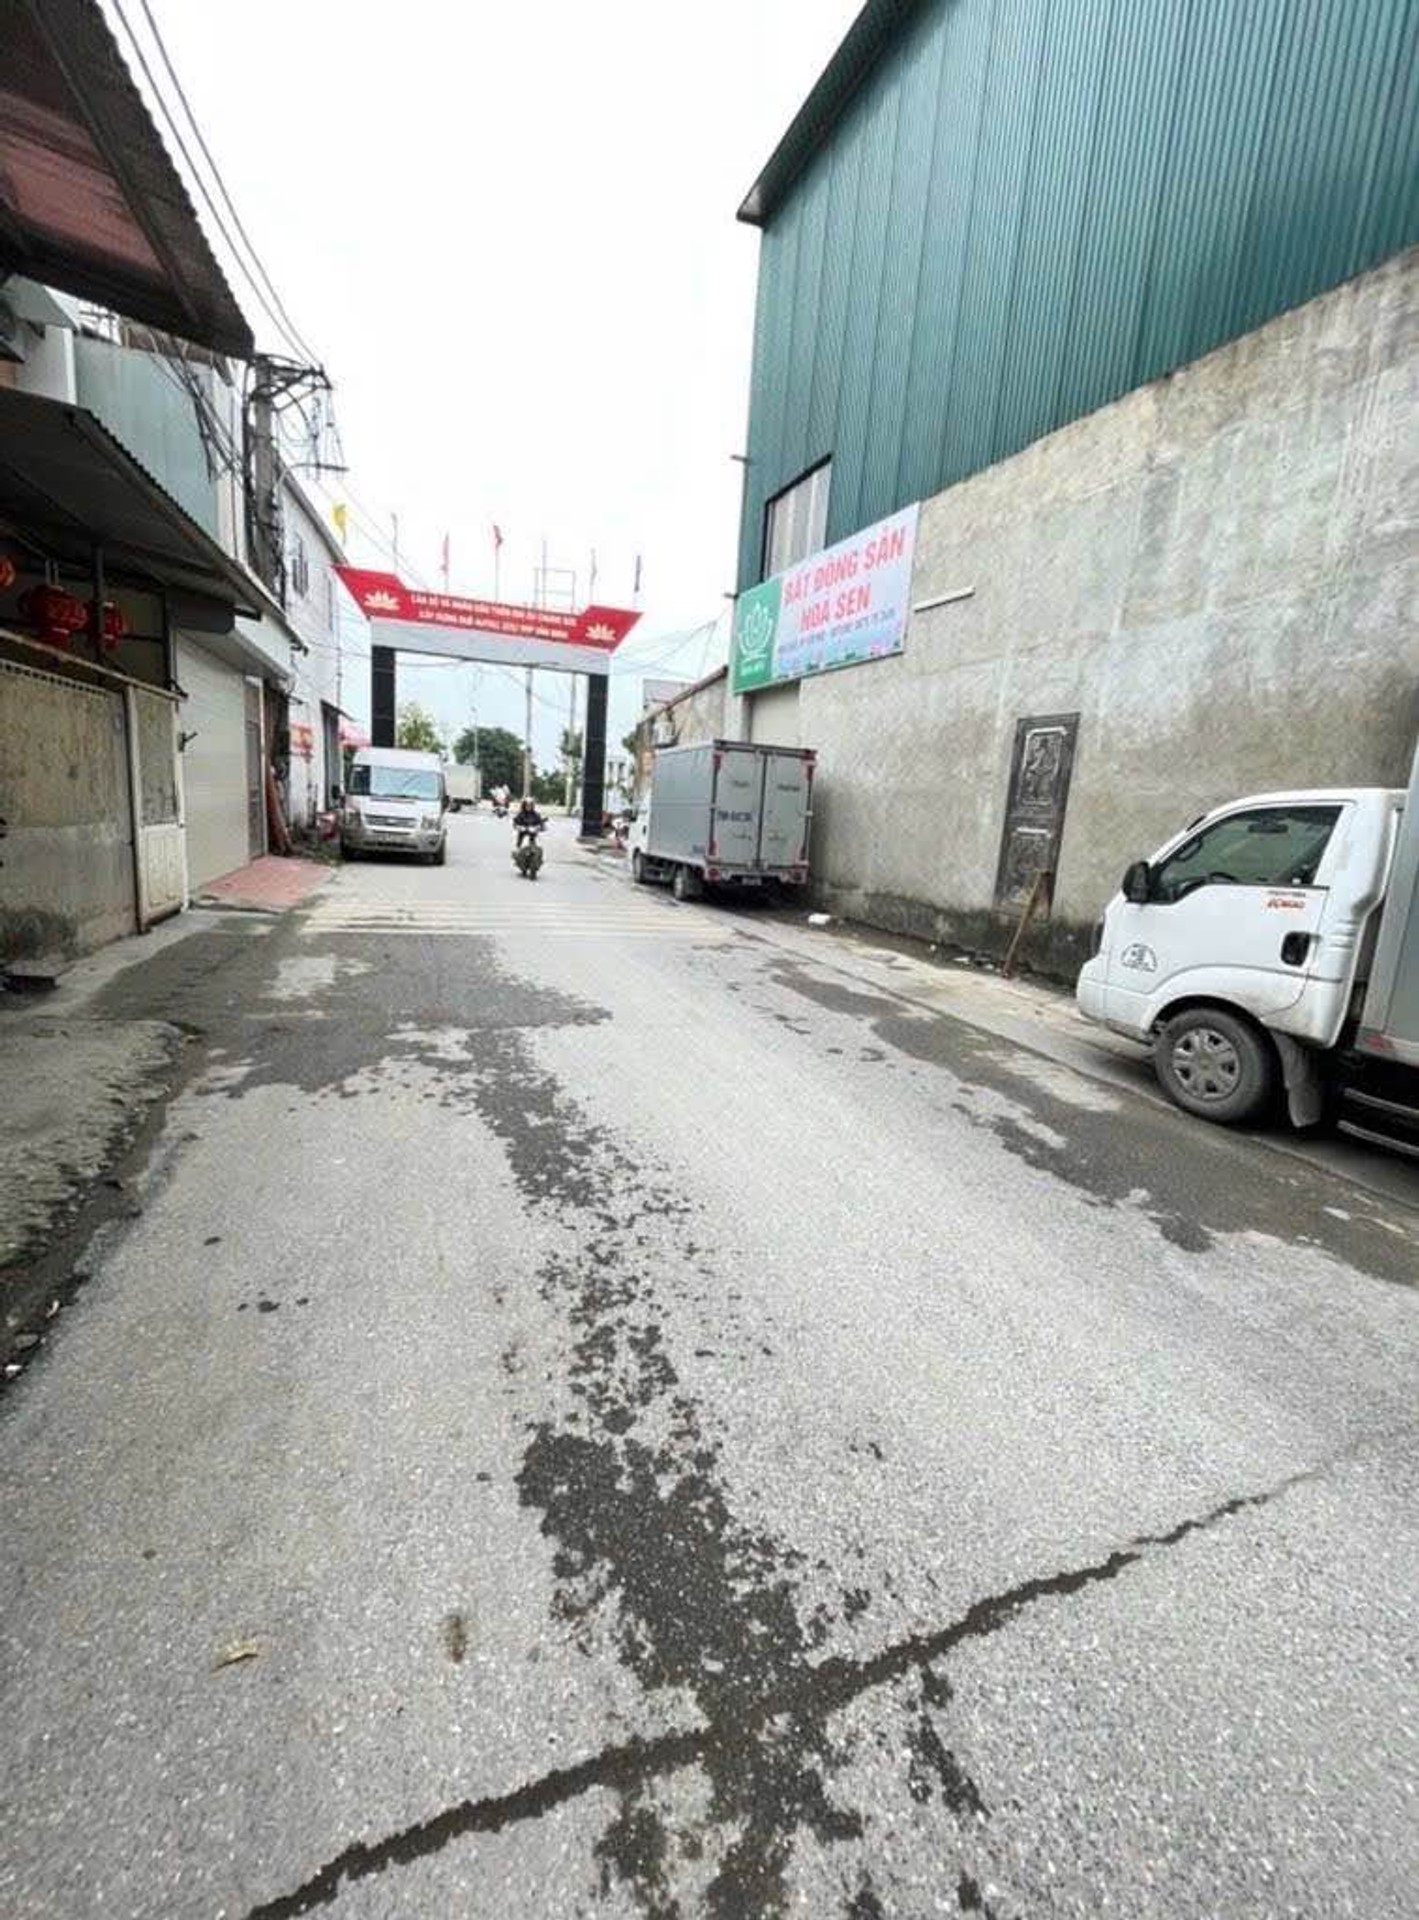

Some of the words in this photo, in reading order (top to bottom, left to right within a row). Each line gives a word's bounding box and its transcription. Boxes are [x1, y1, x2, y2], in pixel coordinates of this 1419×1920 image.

[864, 526, 906, 570] SẢN
[801, 598, 829, 632] HOA
[836, 583, 871, 619] SEN
